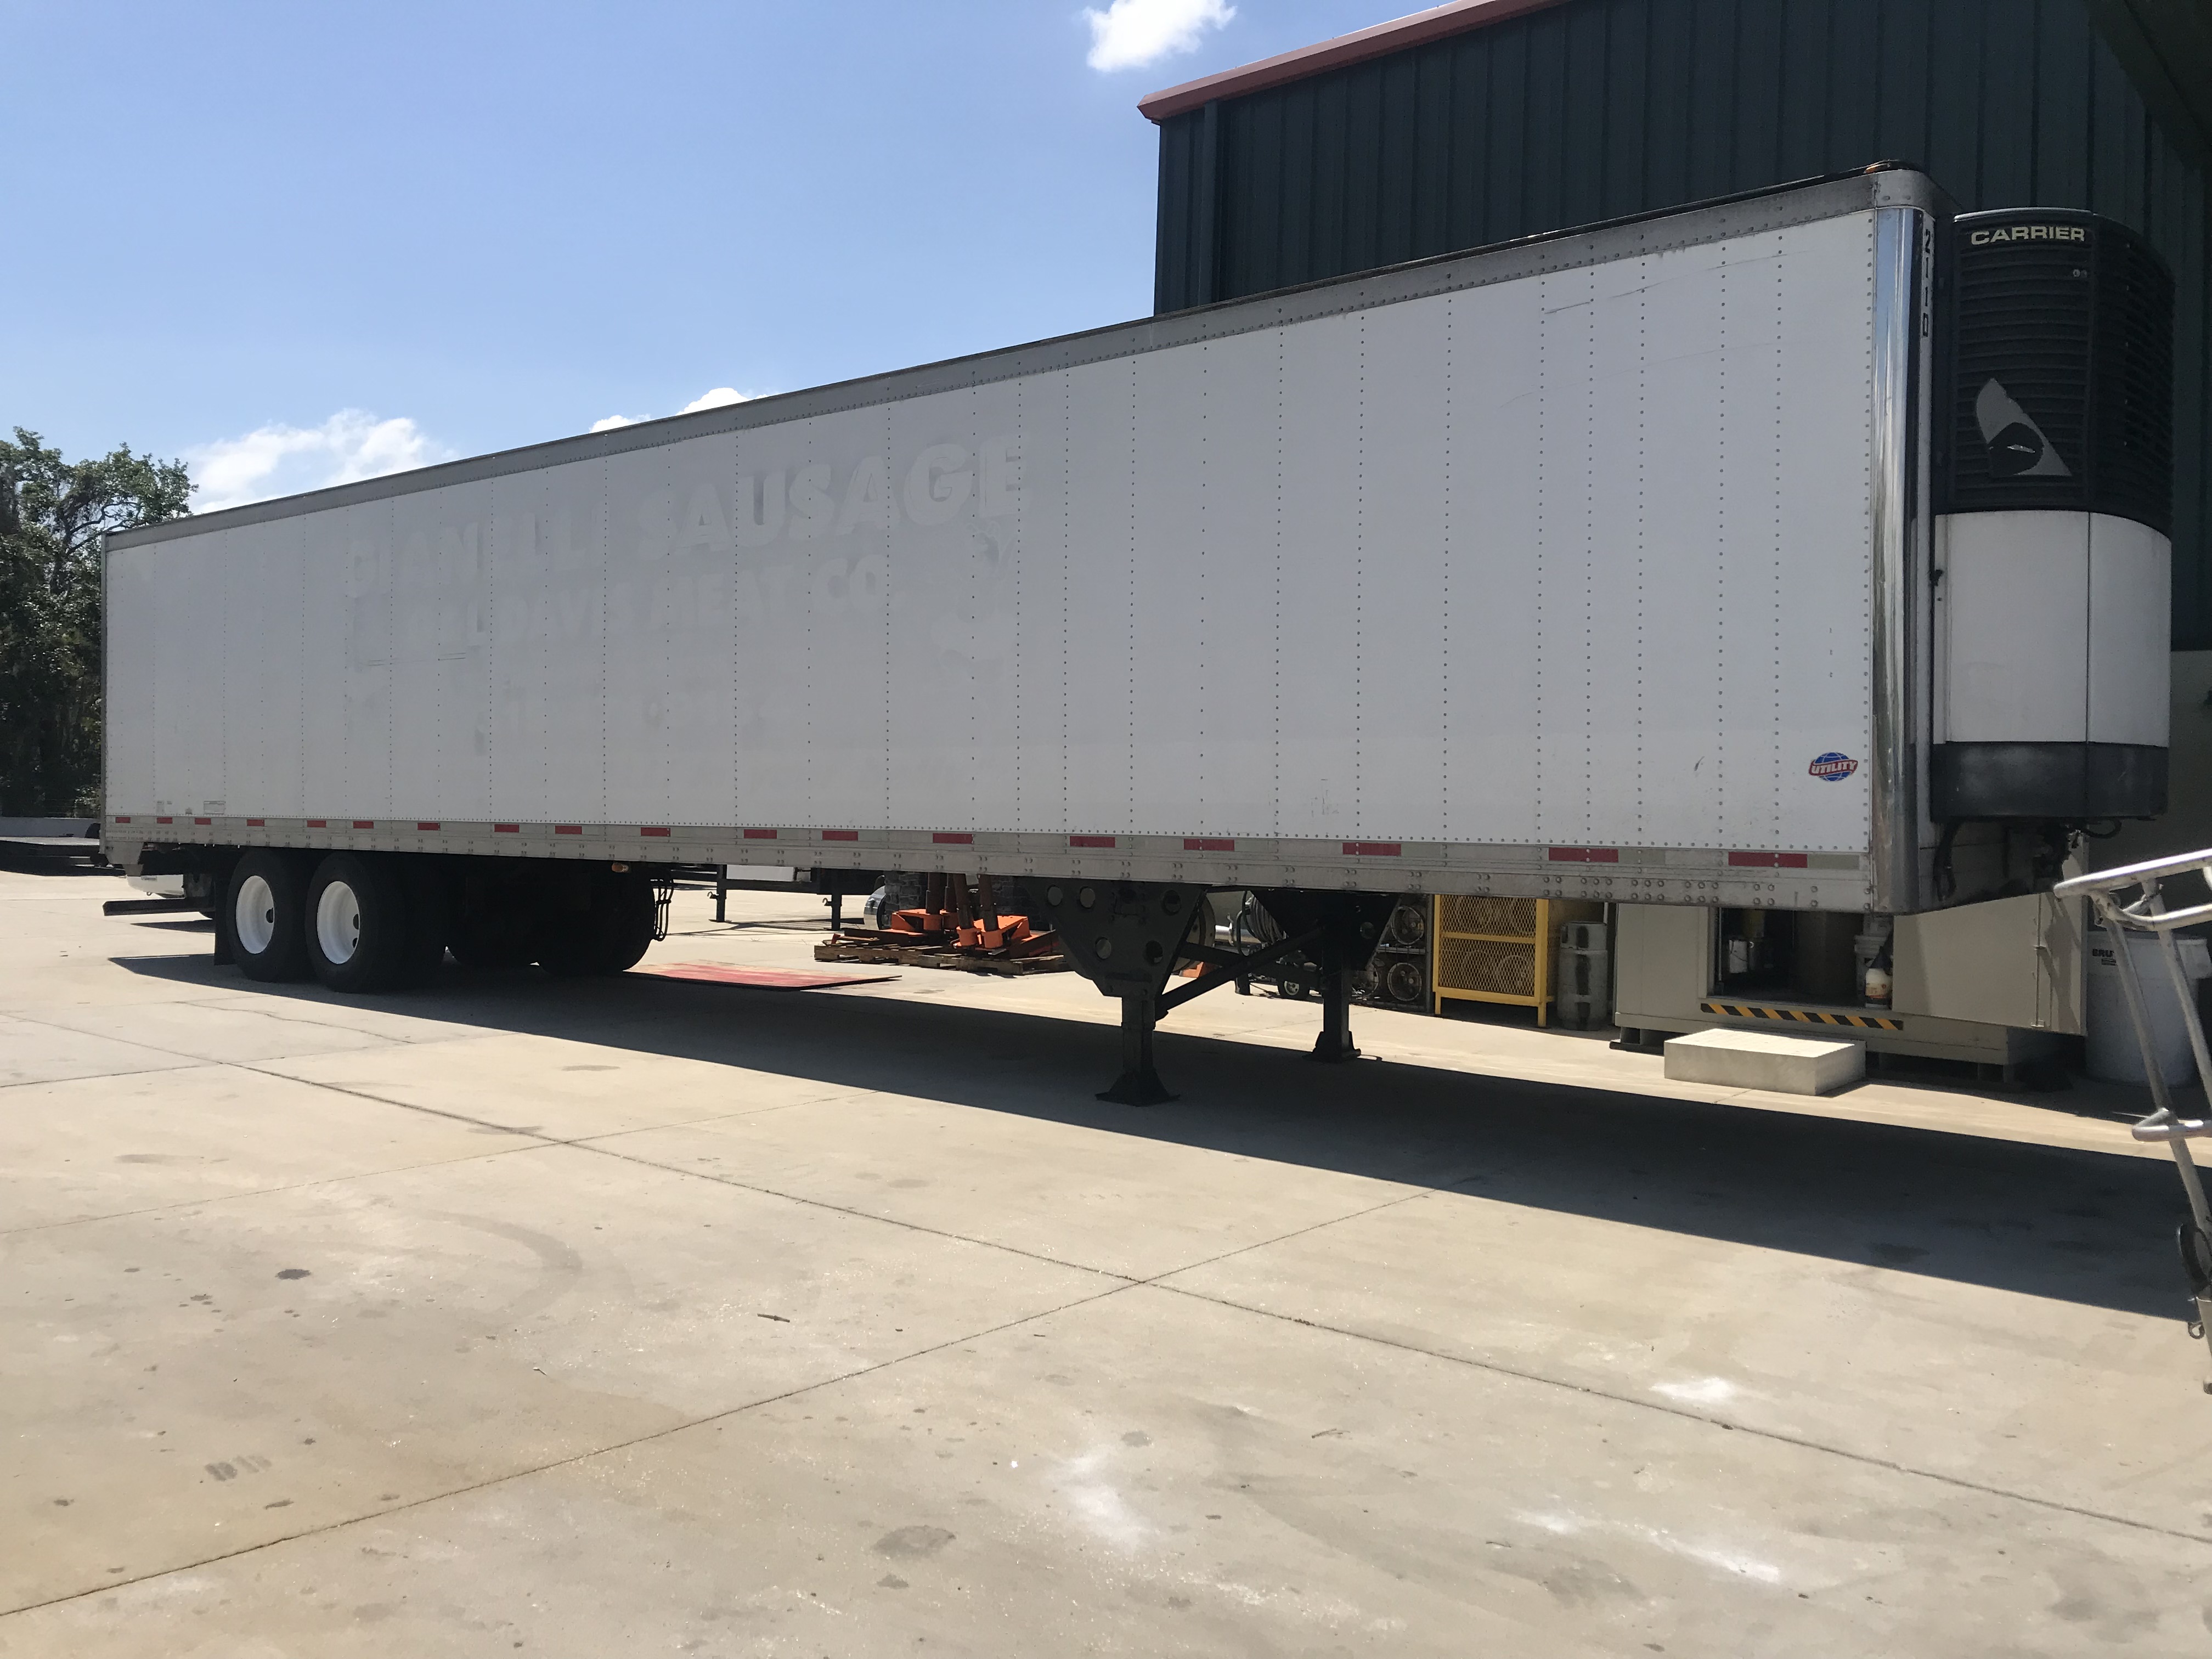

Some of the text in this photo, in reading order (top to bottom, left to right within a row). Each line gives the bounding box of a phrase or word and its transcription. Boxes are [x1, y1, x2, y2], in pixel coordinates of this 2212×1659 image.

[1971, 226, 2085, 245] CARRIER
[636, 431, 1032, 561] SAUSAGE
[1811, 761, 1857, 774] UTILITY
[2092, 949, 2115, 958] BRU
